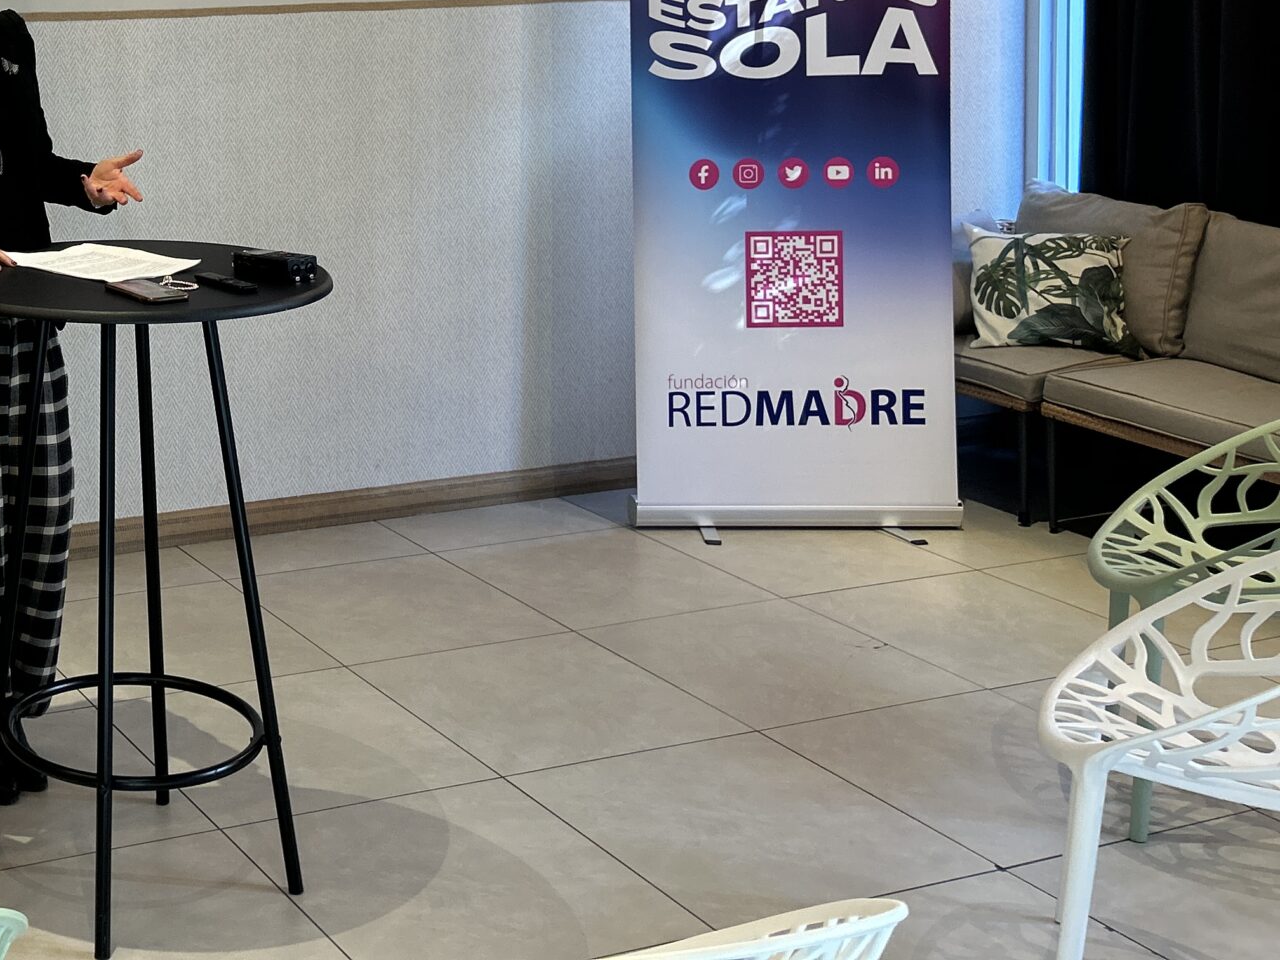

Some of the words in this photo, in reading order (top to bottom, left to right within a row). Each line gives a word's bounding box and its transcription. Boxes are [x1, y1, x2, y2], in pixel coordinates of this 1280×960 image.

[648, 7, 939, 80] SOLA
[668, 374, 749, 390] fundación
[668, 388, 926, 428] REDMADRE
